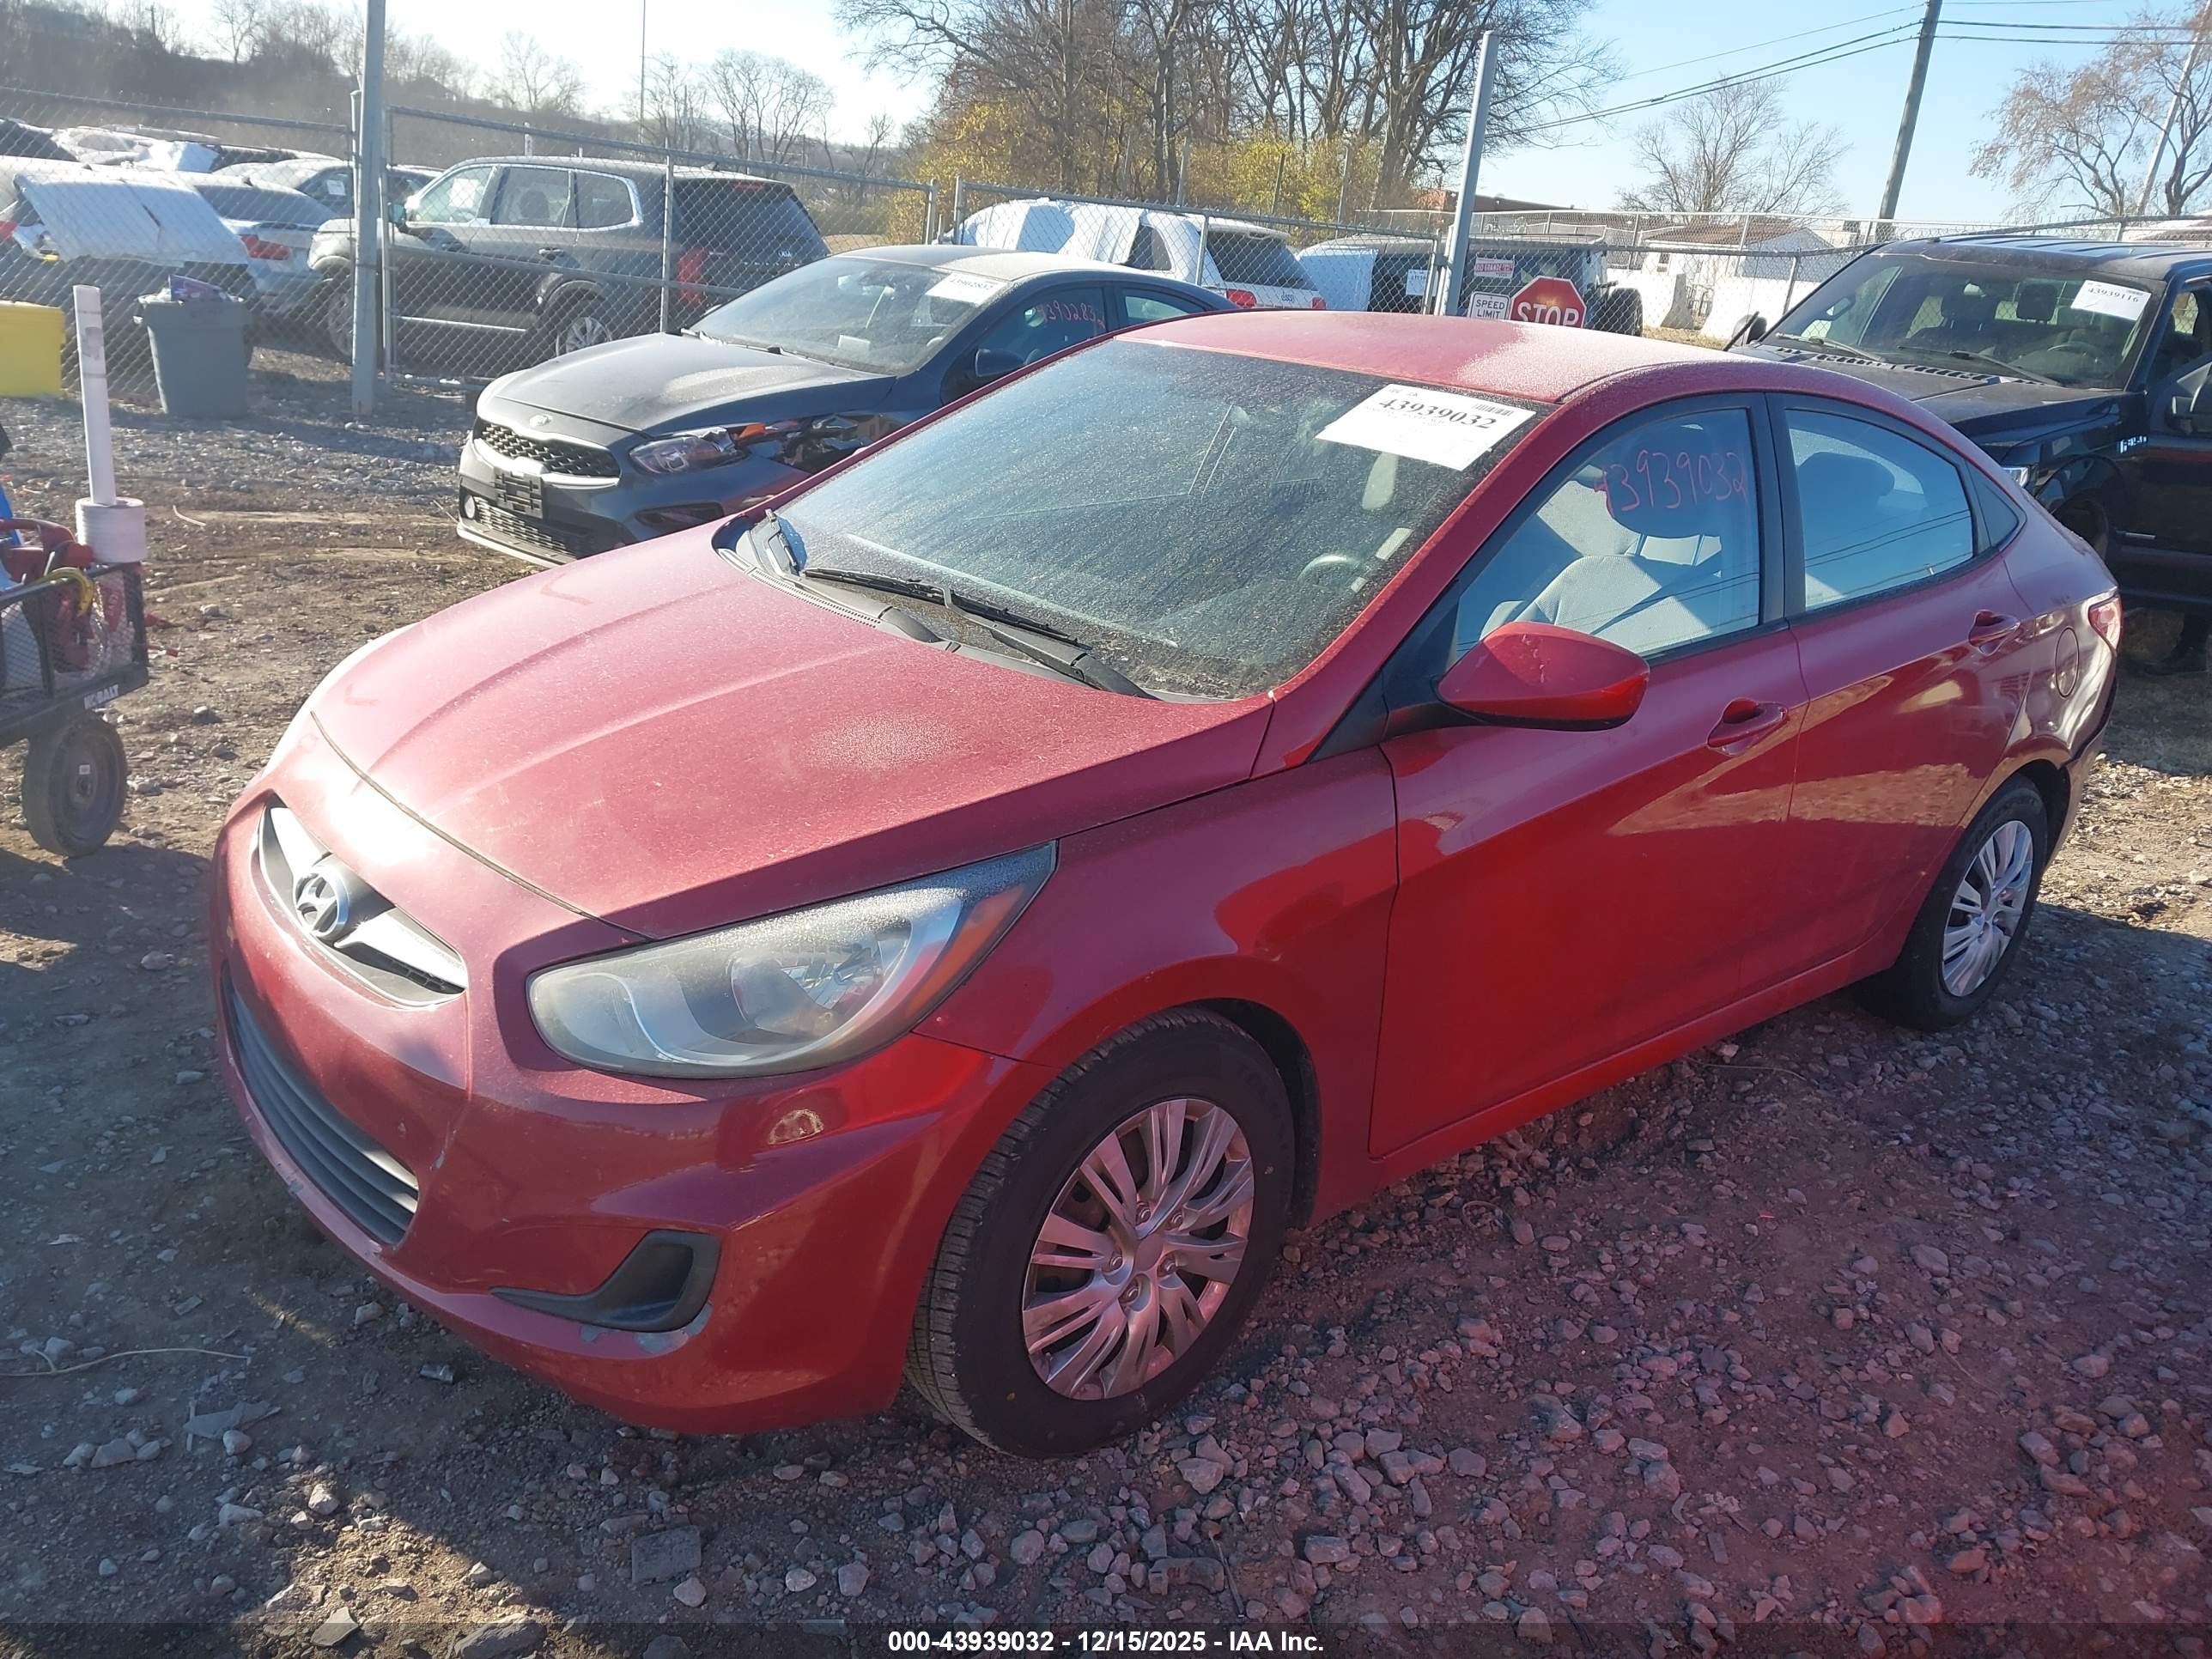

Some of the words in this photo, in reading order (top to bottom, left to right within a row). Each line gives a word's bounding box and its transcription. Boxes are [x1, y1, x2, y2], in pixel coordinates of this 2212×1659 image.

[1476, 299, 1504, 310] SPEED
[2087, 288, 2139, 303] 43939116
[1477, 310, 1501, 319] LIMIT
[1517, 301, 1580, 327] STOP
[1378, 398, 1498, 429] 43939032
[1594, 449, 1747, 520] 43939032
